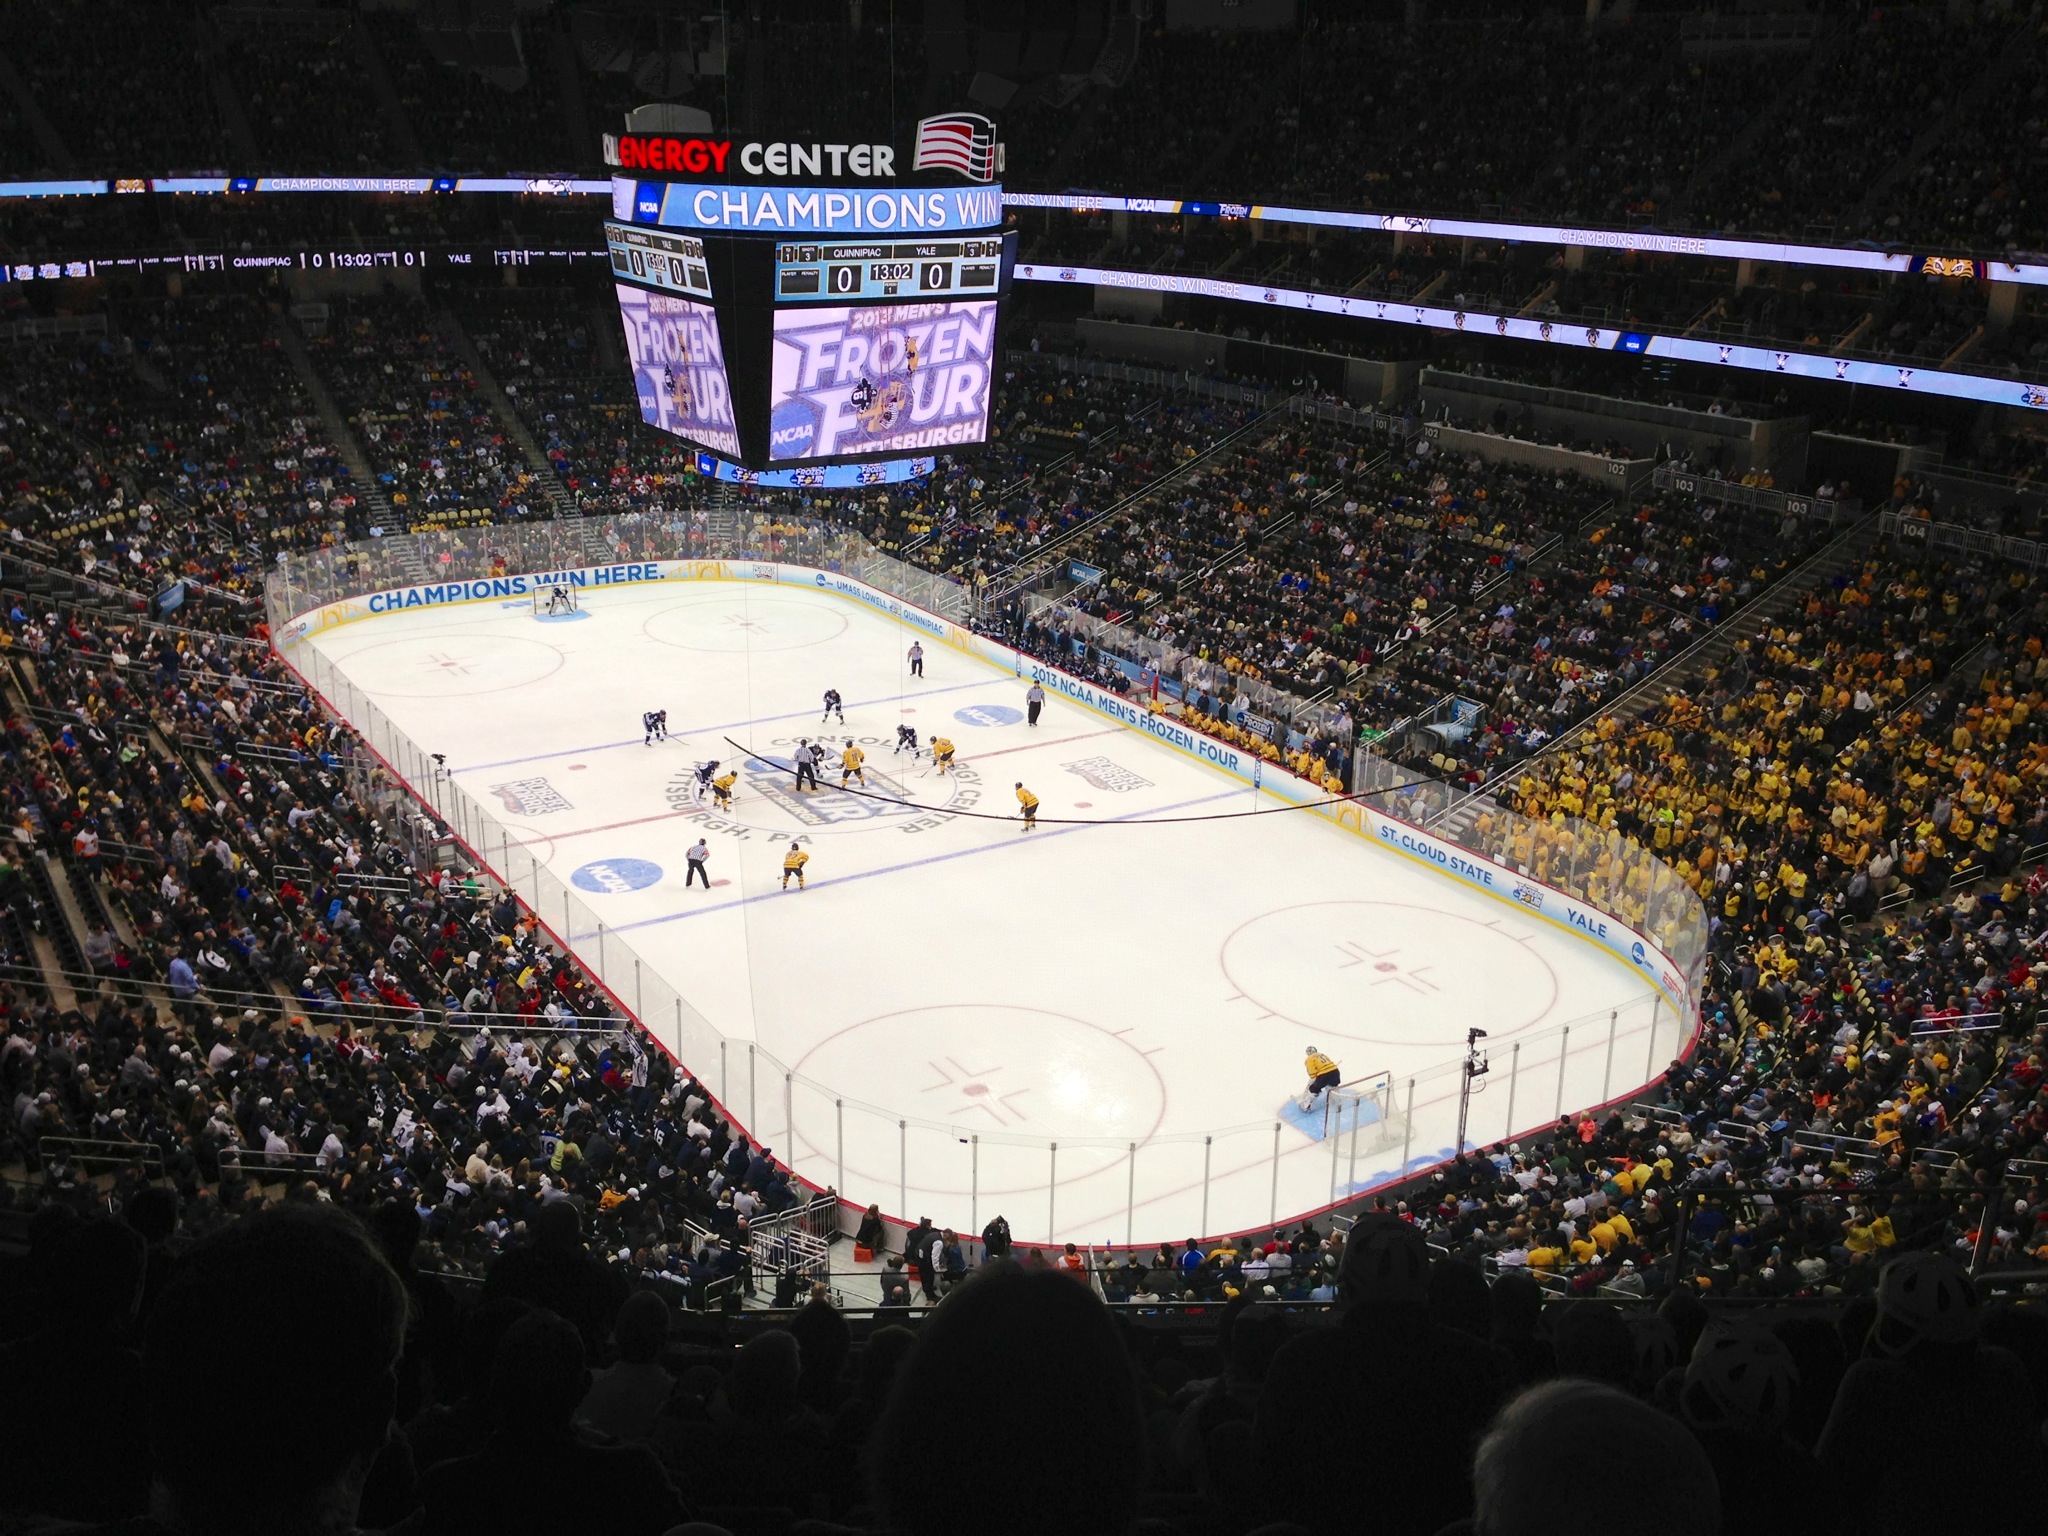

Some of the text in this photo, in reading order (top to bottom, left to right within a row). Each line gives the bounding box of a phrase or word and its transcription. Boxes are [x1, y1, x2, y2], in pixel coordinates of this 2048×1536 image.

[619, 135, 896, 176] ENERGY CENTER
[272, 179, 420, 190] CHAMPIONS WIN HERE.
[693, 190, 996, 229] CHAMPIONS WIN
[1039, 195, 1065, 207] WIN
[1127, 198, 1155, 211] NCAA
[1219, 203, 1248, 216] FROZEN
[1560, 230, 1708, 253] CHAMPIONS WIN HERE.
[233, 251, 472, 268] QUINNIPIAC 0 13:02 0 YALE
[805, 253, 811, 262] 3
[833, 246, 936, 259] QUINNIPIAC YALE
[969, 248, 975, 257] 3
[632, 252, 682, 284] 0 13:02 0
[872, 264, 910, 280] 13:02
[928, 264, 943, 289] 0
[837, 267, 853, 292] 0
[1100, 271, 1241, 298] CHAMPIONS WIN HERE
[894, 303, 946, 323] MEN'S
[624, 309, 722, 366] FROZEN
[791, 312, 994, 388] FROZEN
[804, 363, 984, 456] FUR
[1304, 404, 1316, 416] 101
[772, 423, 814, 446] NCAA
[1375, 419, 1387, 430] 101
[1424, 427, 1439, 439] 102
[795, 466, 825, 477] FROZEN
[860, 464, 888, 475] FROZEN
[1608, 463, 1626, 476] 102
[1675, 479, 1694, 493] 103
[1786, 500, 1808, 515] 103
[1902, 523, 1926, 538] 104
[369, 575, 527, 614] CHAMPIONS
[594, 563, 666, 585] HERE.
[836, 580, 861, 597] UMASS
[861, 588, 888, 610] LOWELL
[903, 609, 943, 635] QUINNIPIAC
[1032, 665, 1239, 772] 2013 NCAA MEN'S FROZEN FOUR
[767, 832, 813, 845] PA
[1381, 824, 1493, 885] ST. CLOUD STATE
[584, 864, 633, 894] NCAA
[1516, 880, 1544, 900] FROZEN
[1566, 907, 1608, 939] YALE
